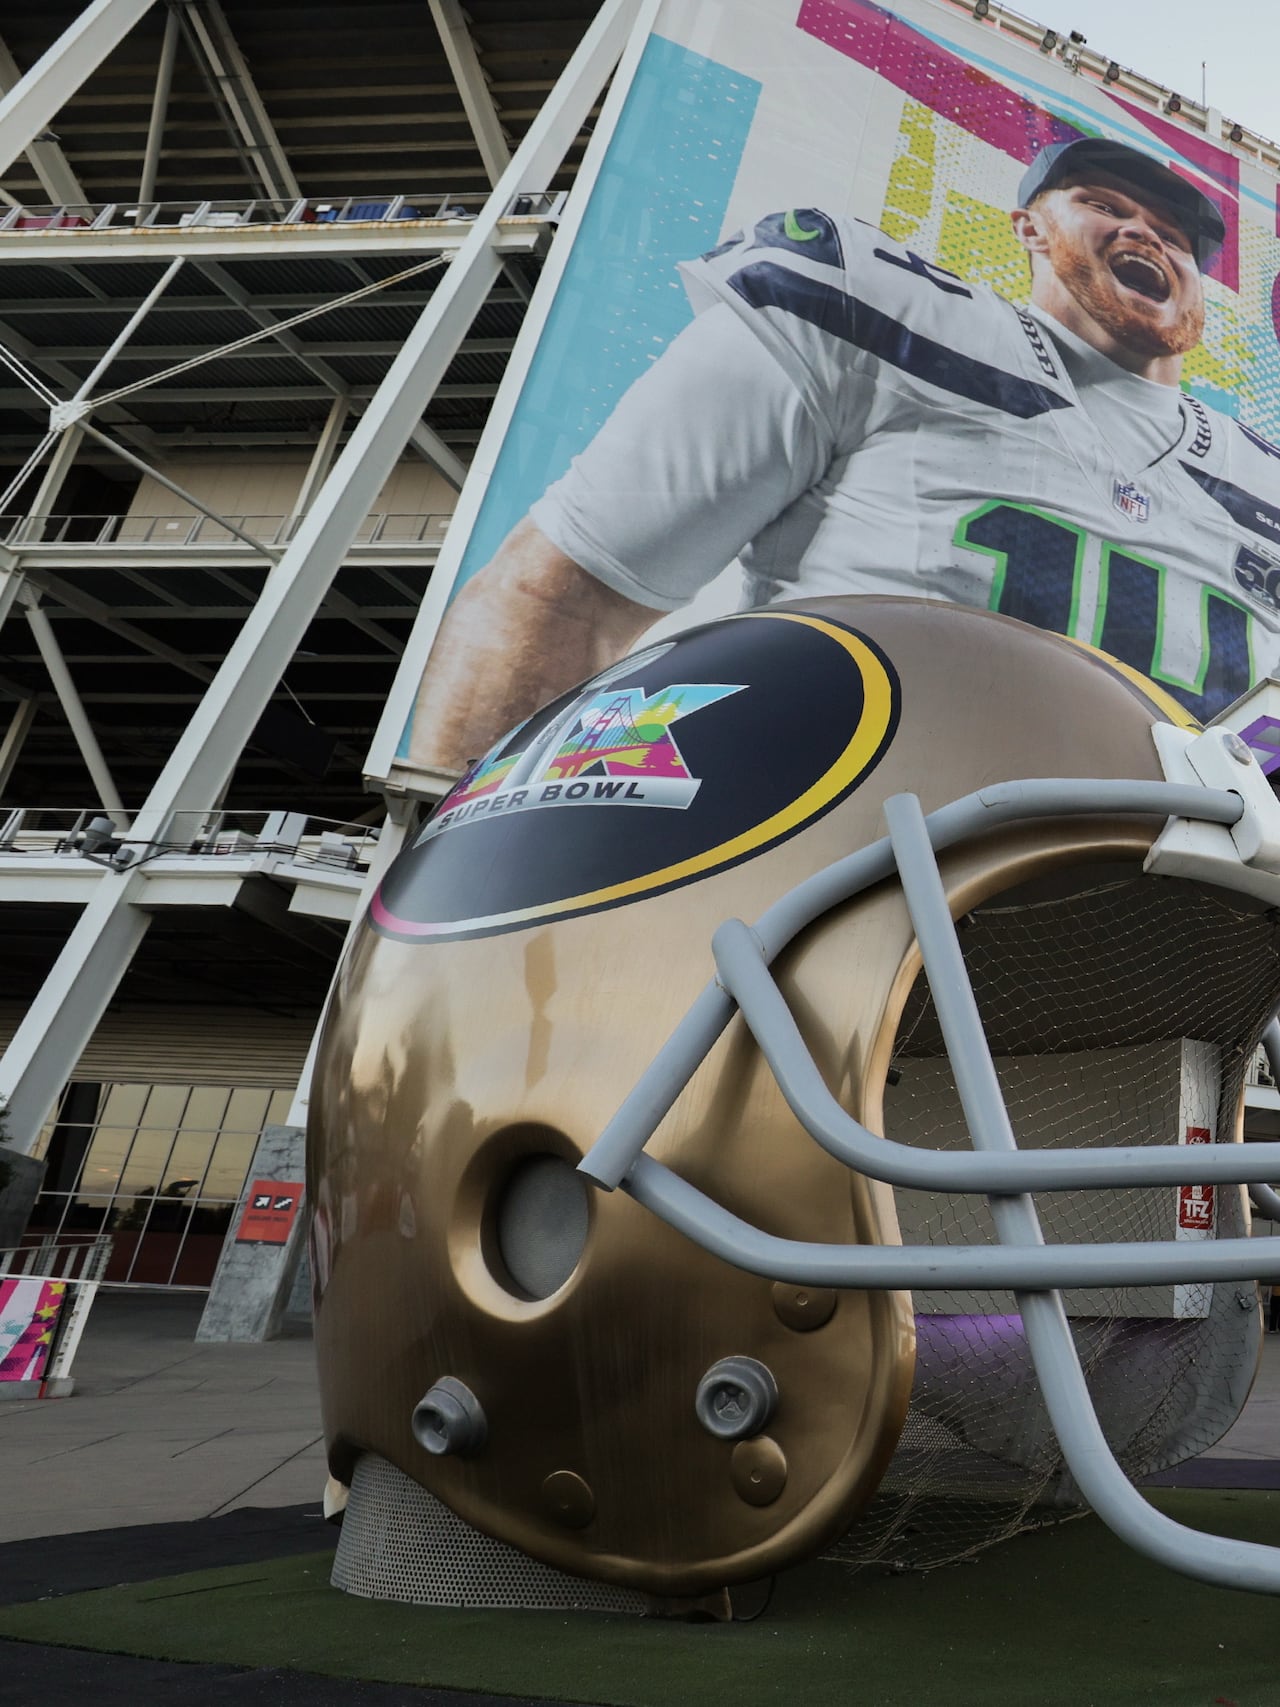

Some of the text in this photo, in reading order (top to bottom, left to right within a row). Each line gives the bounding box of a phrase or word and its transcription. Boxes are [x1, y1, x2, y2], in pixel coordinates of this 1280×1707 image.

[1120, 495, 1145, 518] NFL
[437, 781, 646, 829] SUPER BOWL
[1183, 1199, 1210, 1219] TFZ
